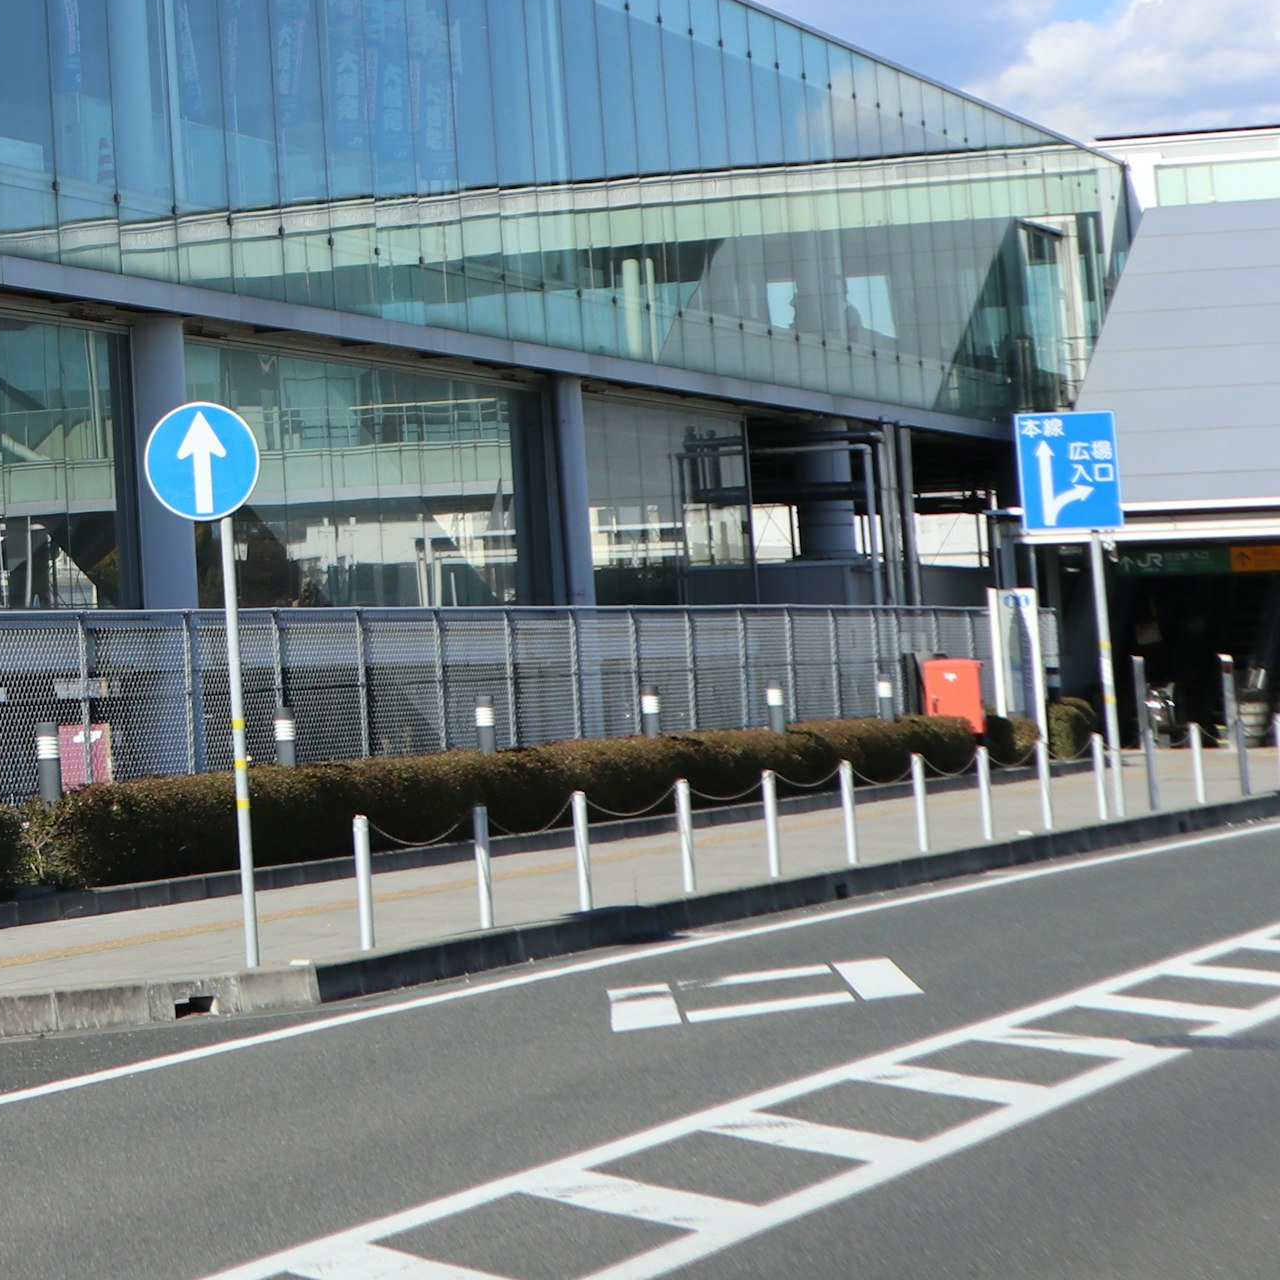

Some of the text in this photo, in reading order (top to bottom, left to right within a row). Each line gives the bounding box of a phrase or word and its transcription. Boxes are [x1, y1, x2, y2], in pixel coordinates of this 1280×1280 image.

[1019, 417, 1066, 439] 本線
[1068, 439, 1113, 461] 広場
[1070, 462, 1115, 484] 入口
[1136, 552, 1164, 568] JR
